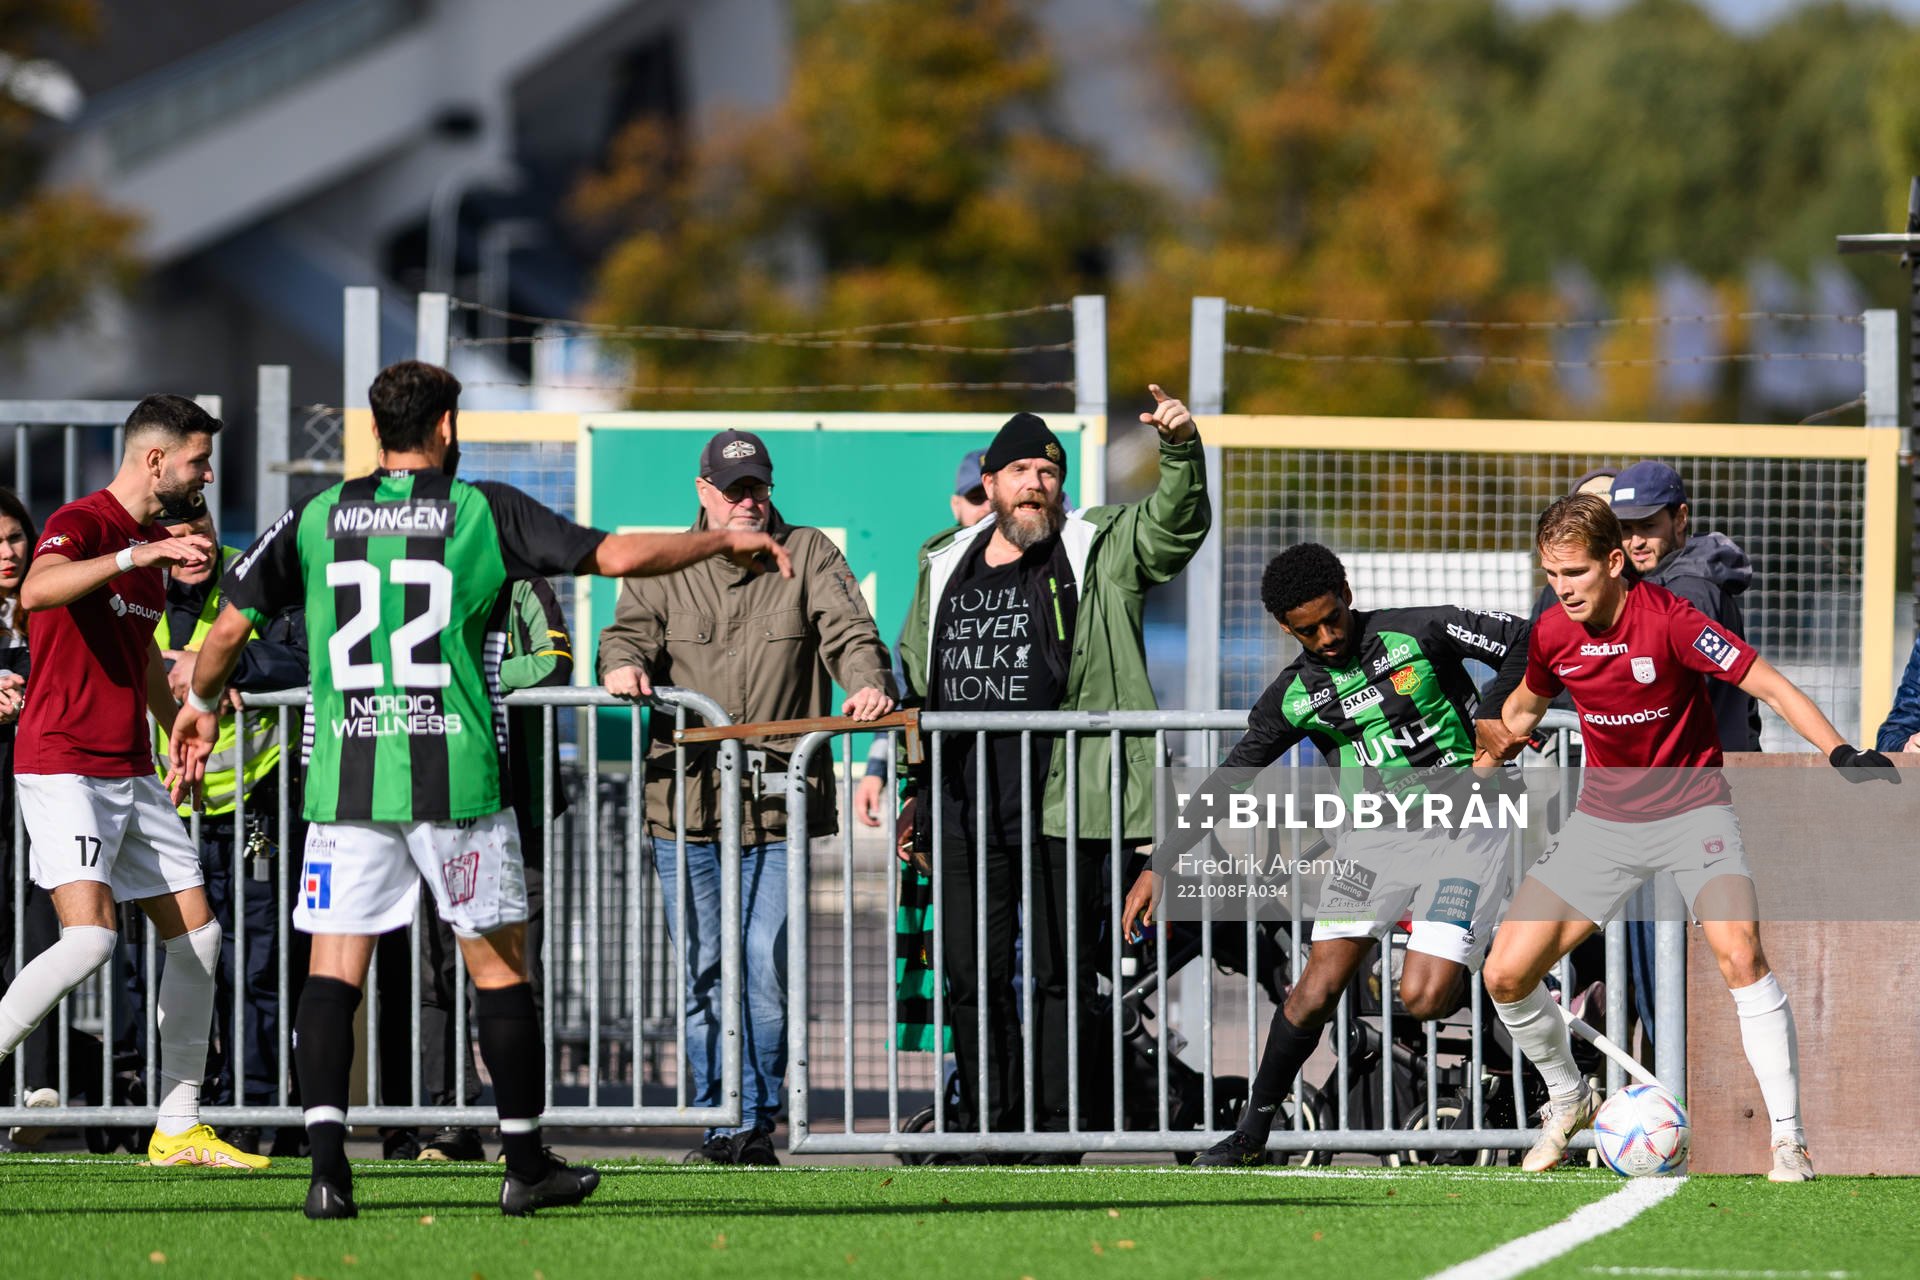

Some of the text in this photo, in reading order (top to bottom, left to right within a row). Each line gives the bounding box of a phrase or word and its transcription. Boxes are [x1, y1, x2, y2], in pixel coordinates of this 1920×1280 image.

[334, 506, 447, 532] NIDINGEN
[326, 559, 453, 691] 22
[943, 613, 1029, 640] NEVER
[1446, 623, 1507, 657] stadium
[1580, 643, 1629, 657] stadium
[1372, 644, 1410, 671] SALDO
[351, 695, 436, 717] NORDIC
[1292, 688, 1330, 712] SALDO
[1343, 687, 1378, 711] SKAB
[332, 714, 462, 739] WELLNESS
[75, 836, 102, 867] 17
[1441, 884, 1473, 898] ADVOKAT
[1446, 907, 1467, 920] OPUS
